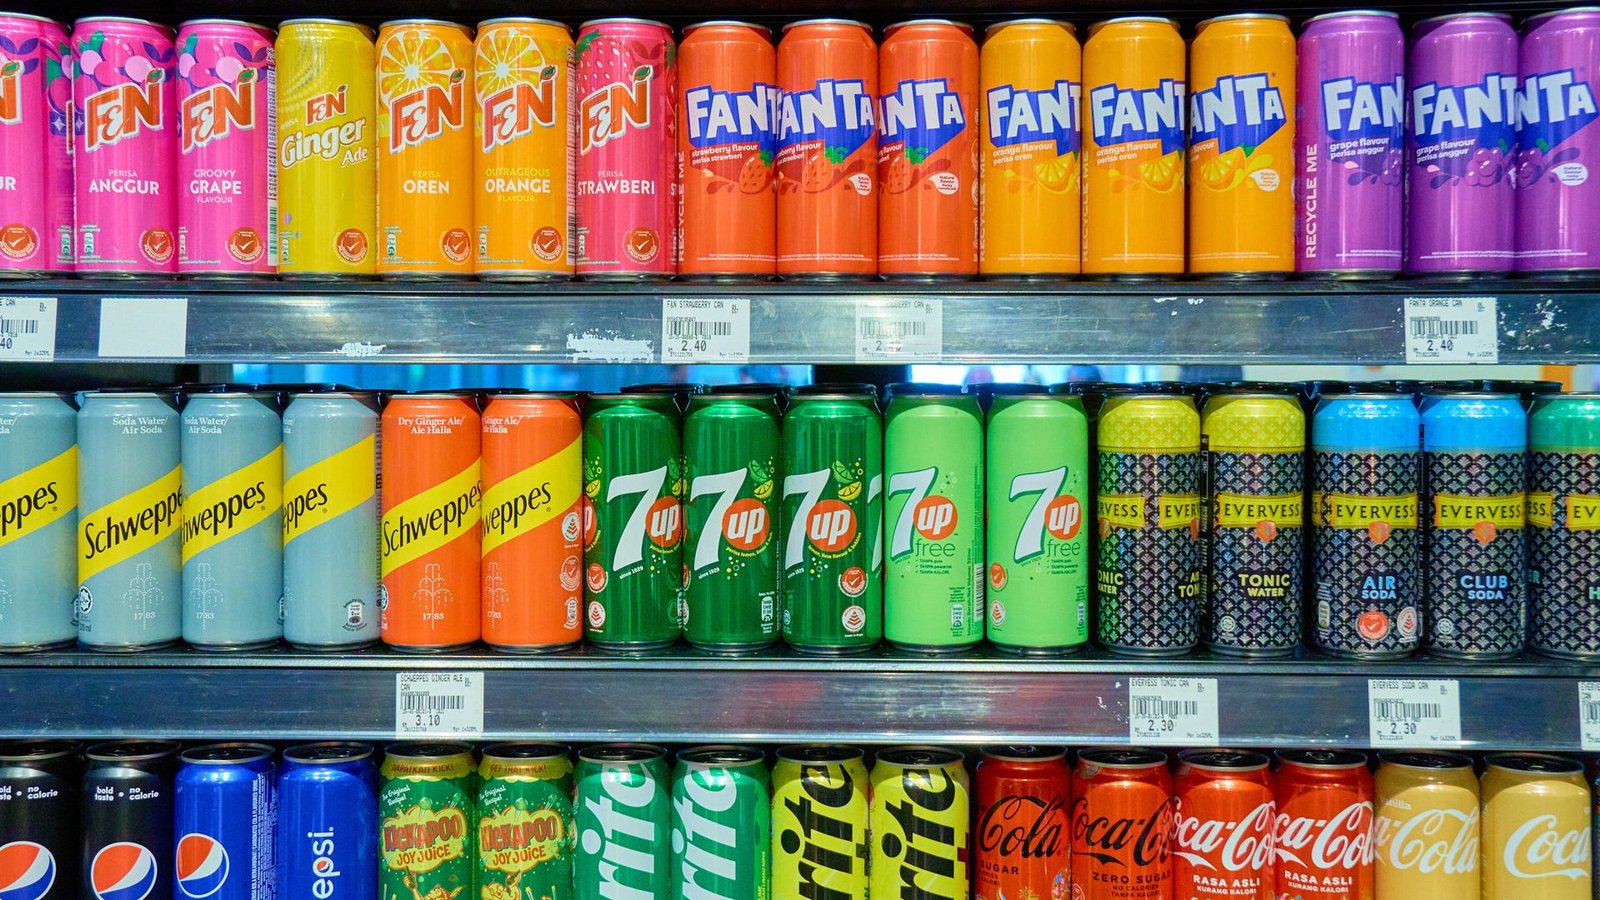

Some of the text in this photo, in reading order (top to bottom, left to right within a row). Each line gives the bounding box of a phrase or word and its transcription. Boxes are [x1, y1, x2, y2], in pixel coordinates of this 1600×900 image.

[306, 85, 347, 126] F&N
[1190, 75, 1284, 134] ANTA
[1324, 77, 1404, 131] FAN
[1413, 75, 1516, 136] FANT
[1515, 71, 1597, 132] NTA
[86, 71, 164, 153] F&N
[182, 71, 256, 154] F&N
[390, 69, 465, 154] F&N
[483, 68, 557, 154] F&N
[580, 68, 654, 155] F&N
[687, 82, 777, 139] FANT
[989, 82, 1081, 139] FANT
[1092, 81, 1185, 138] FANT
[281, 117, 366, 168] Ginger
[796, 142, 822, 152] flavour
[1330, 138, 1389, 152] grape flavour
[1416, 139, 1476, 157] grape flavour
[341, 146, 368, 167] Ade
[692, 143, 758, 158] strawberry flavour
[992, 143, 1053, 157] orange flavour
[1096, 142, 1158, 158] orange flavour
[1331, 146, 1385, 159] perisa anggur
[1417, 148, 1469, 164] perisa anggur
[692, 153, 742, 166] perisa strawberi
[993, 157, 1014, 166] perisa
[1096, 152, 1137, 166] perisa oren
[108, 169, 138, 177] PERISA
[193, 169, 237, 178] GROOVY
[485, 168, 550, 178] OUTRAGEOUS
[597, 170, 624, 178] PERISA
[89, 179, 160, 195] ANGGUR
[189, 179, 242, 195] GRAPE
[403, 180, 450, 194] OREN
[485, 179, 551, 193] ORANGE
[577, 180, 656, 195] STRAWBERI
[196, 196, 233, 204] FLAVOUR
[1306, 144, 1317, 259] RECYCLE ME
[680, 300, 712, 309] STRAWBERRY
[714, 300, 724, 309] CAN
[1409, 299, 1462, 307] FANTA ORANGE CAN
[681, 340, 707, 352] 2.40
[1427, 340, 1453, 351] 2.40
[113, 417, 136, 426] Soda
[184, 416, 199, 425] Soda
[398, 417, 414, 426] Dry
[415, 417, 447, 427] Ginger
[122, 426, 163, 434] Air Soda
[188, 425, 222, 434] Air Soda
[410, 426, 453, 434] Ale Halia
[490, 426, 508, 434] Halia
[0, 481, 58, 537] ppes
[183, 481, 266, 540] hweppes
[482, 481, 551, 538] weppes
[1225, 502, 1300, 518] EVERVESS
[1336, 504, 1415, 519] EVERVESS
[1440, 503, 1521, 519] EVERVESS
[85, 487, 182, 560] Schweppe
[915, 539, 956, 557] free
[1047, 539, 1080, 557] free
[632, 566, 644, 574] 1929
[708, 566, 720, 575] 1929
[1238, 573, 1290, 588] TONIC
[1362, 575, 1396, 590] AIR
[1460, 575, 1508, 589] CLUB
[1247, 587, 1284, 597] WATER
[1361, 590, 1397, 600] SODA
[1467, 589, 1504, 600] SODA
[400, 674, 463, 682] SCHWEPPES GINGER ALE
[1131, 679, 1190, 687] EVERVESS TONIC CAN
[401, 684, 410, 692] CAN
[1372, 681, 1399, 690] EVERVESS
[1402, 681, 1415, 689] SODA
[415, 714, 441, 726] 3.10
[1148, 719, 1174, 731] 2.30
[1390, 723, 1417, 734] 2.30
[432, 764, 454, 773] KICK!
[525, 764, 547, 773] KICK!
[28, 789, 58, 800] calorie
[95, 791, 159, 801] taste calorie
[97, 786, 114, 794] bold
[384, 814, 462, 851] KICKAPOO
[480, 814, 557, 851] KICKAPOO
[581, 763, 656, 900] rite
[672, 766, 737, 900] rite
[781, 764, 854, 900] rite
[881, 767, 956, 900] rite
[396, 844, 451, 867] JOY JUICE
[492, 845, 547, 867] JOY JUICE
[1093, 872, 1130, 883] ZERO
[1193, 874, 1260, 888] RASA ASLI
[1284, 870, 1353, 885] RASA ASLI
[1197, 885, 1228, 895] KURANG
[1288, 882, 1319, 892] KURANG
